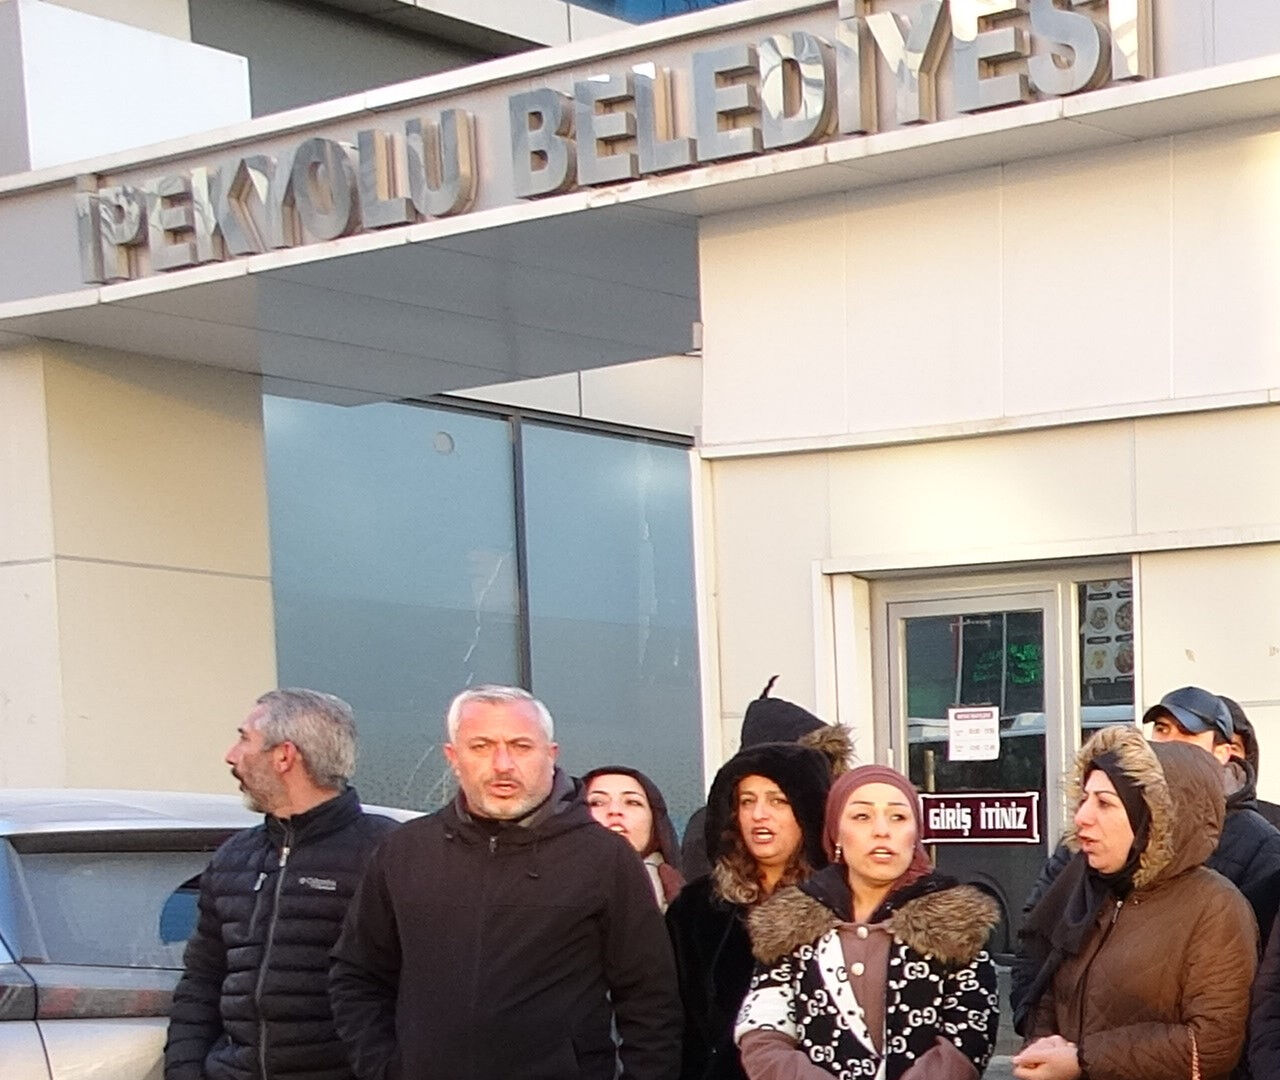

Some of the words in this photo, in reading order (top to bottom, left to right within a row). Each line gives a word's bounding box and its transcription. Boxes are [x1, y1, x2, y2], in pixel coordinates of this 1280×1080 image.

[75, 108, 474, 285] İPEKYOLU
[928, 802, 972, 837] GİRİŞ
[980, 801, 1028, 830] İTİNİZ
